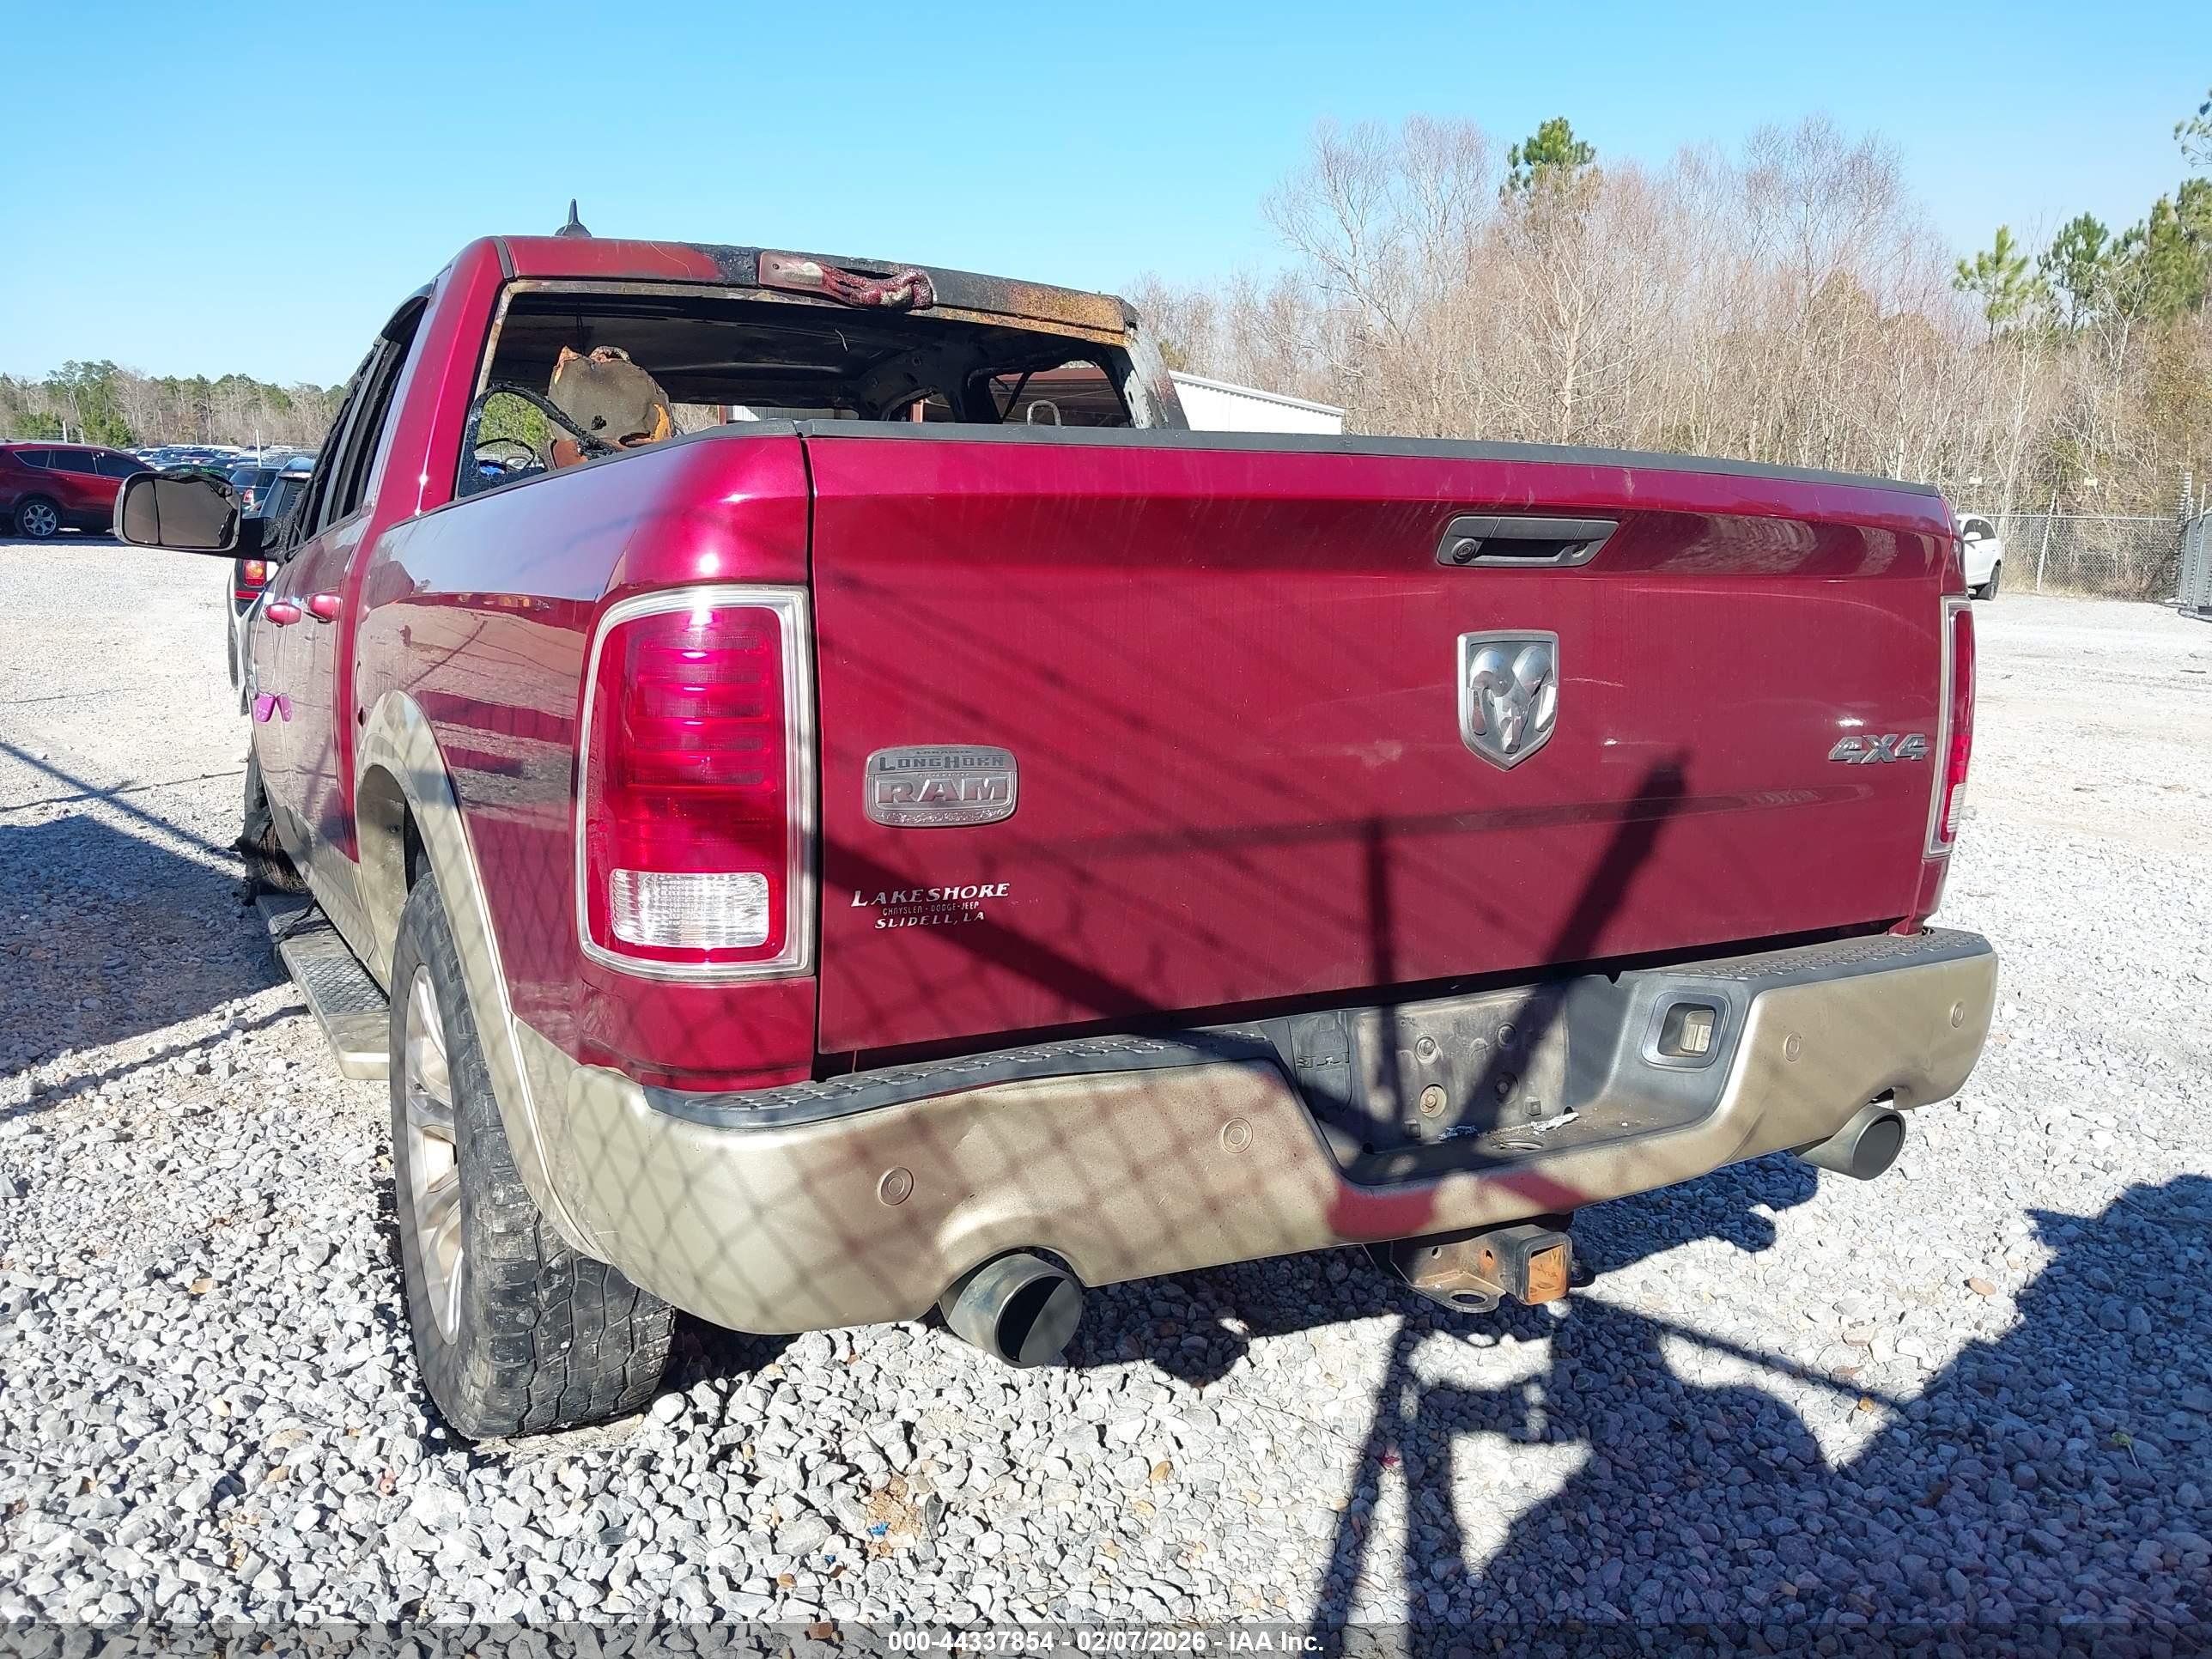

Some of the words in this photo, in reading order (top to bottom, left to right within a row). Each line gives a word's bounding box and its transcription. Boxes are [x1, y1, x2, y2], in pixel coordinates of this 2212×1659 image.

[1828, 733, 1930, 764] 4X4
[877, 777, 1008, 804] RAM
[851, 883, 1010, 908] LAKESHORE
[874, 915, 958, 929] SLIDELL,
[963, 912, 985, 922] LA
